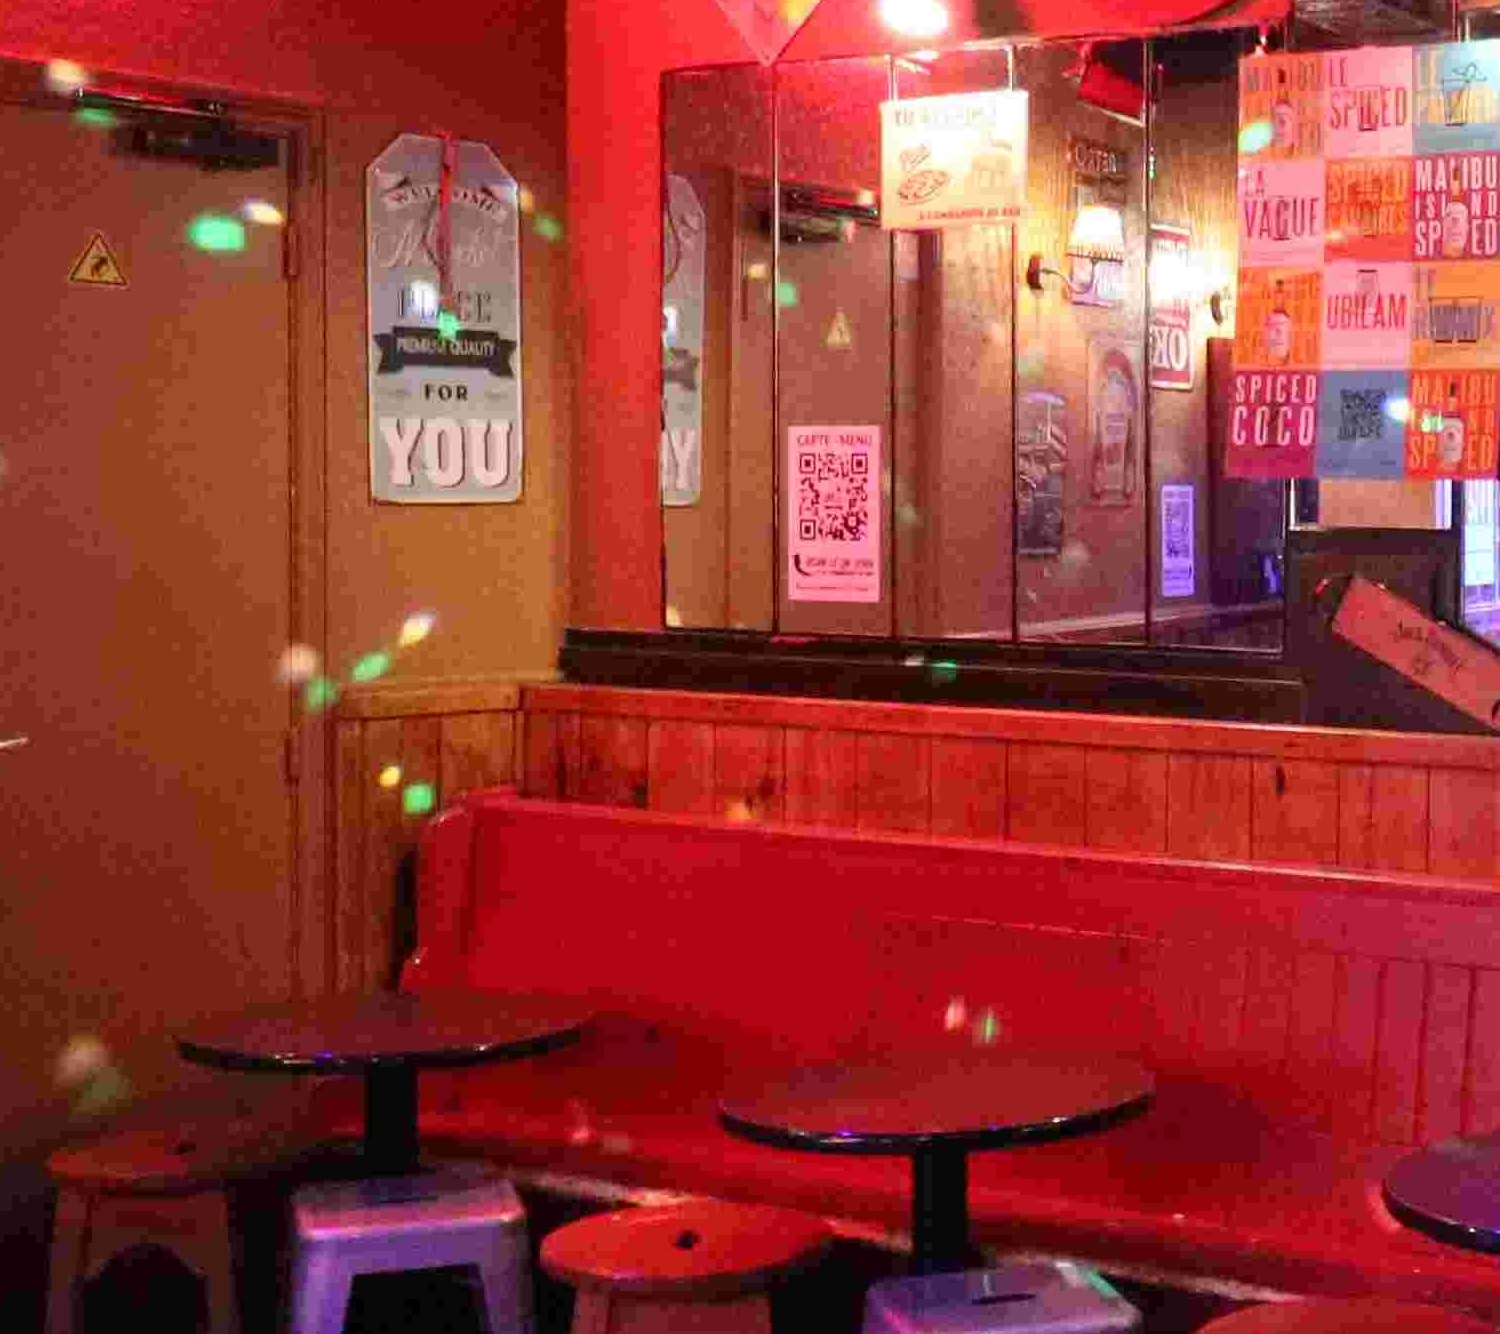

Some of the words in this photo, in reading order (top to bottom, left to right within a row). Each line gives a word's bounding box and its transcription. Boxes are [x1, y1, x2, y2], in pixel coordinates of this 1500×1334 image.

[1244, 196, 1320, 239] VAGUE
[1414, 218, 1498, 257] SPED
[424, 383, 469, 402] FOR
[1235, 374, 1317, 403] SPICED
[1232, 405, 1316, 447] COCO
[380, 417, 514, 490] YOU
